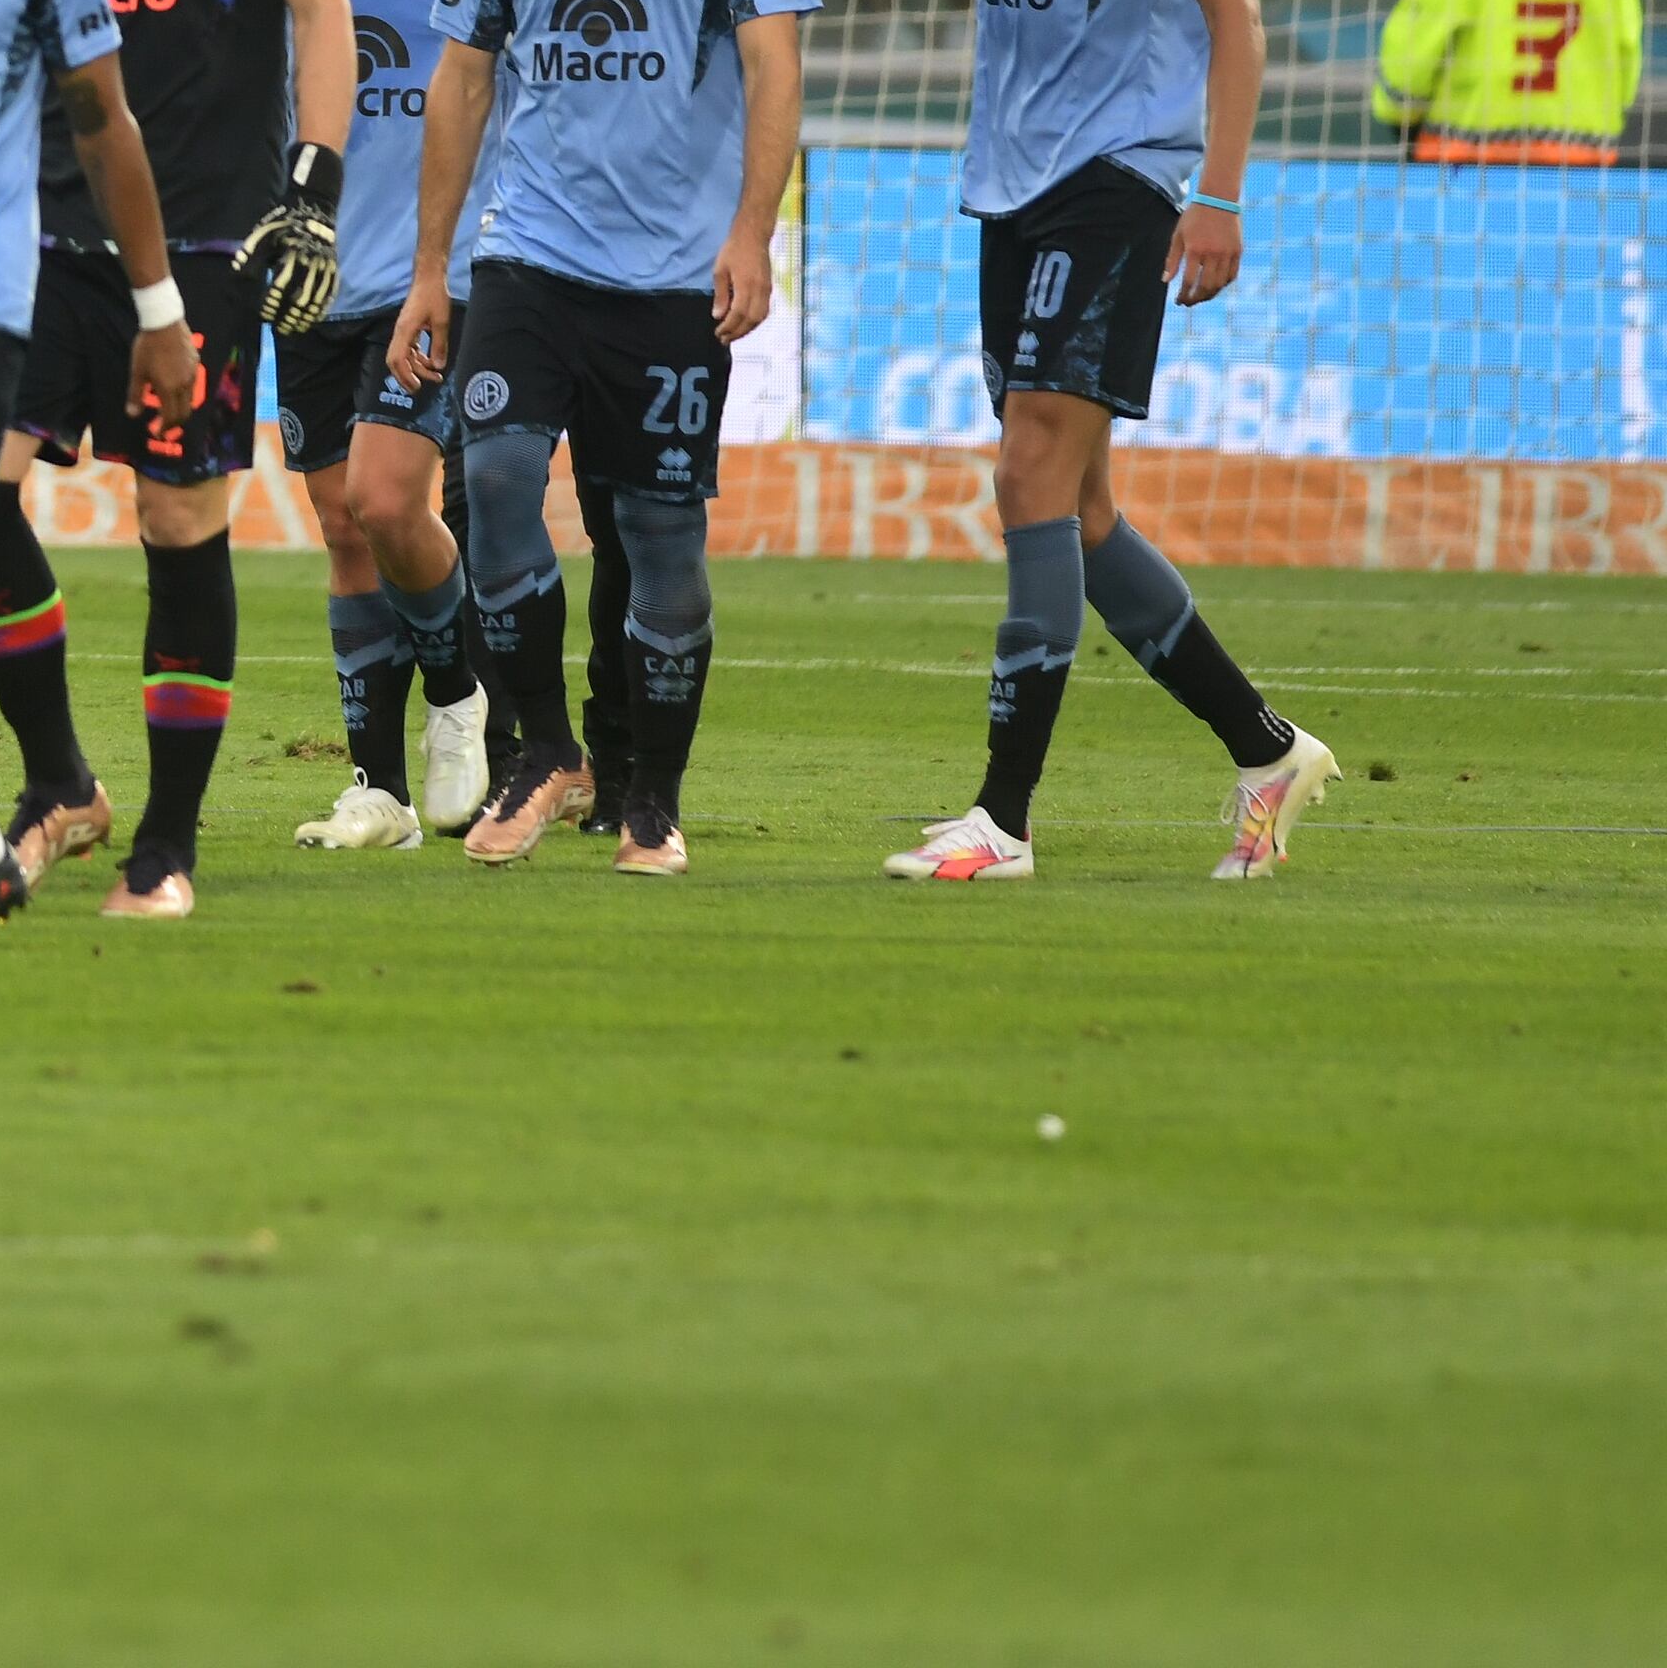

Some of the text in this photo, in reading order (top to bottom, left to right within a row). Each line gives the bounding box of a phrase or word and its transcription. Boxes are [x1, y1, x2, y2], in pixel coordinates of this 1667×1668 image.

[531, 43, 667, 83] Macro
[357, 87, 427, 117] cro
[642, 365, 710, 435] 26
[644, 655, 696, 674] CAB
